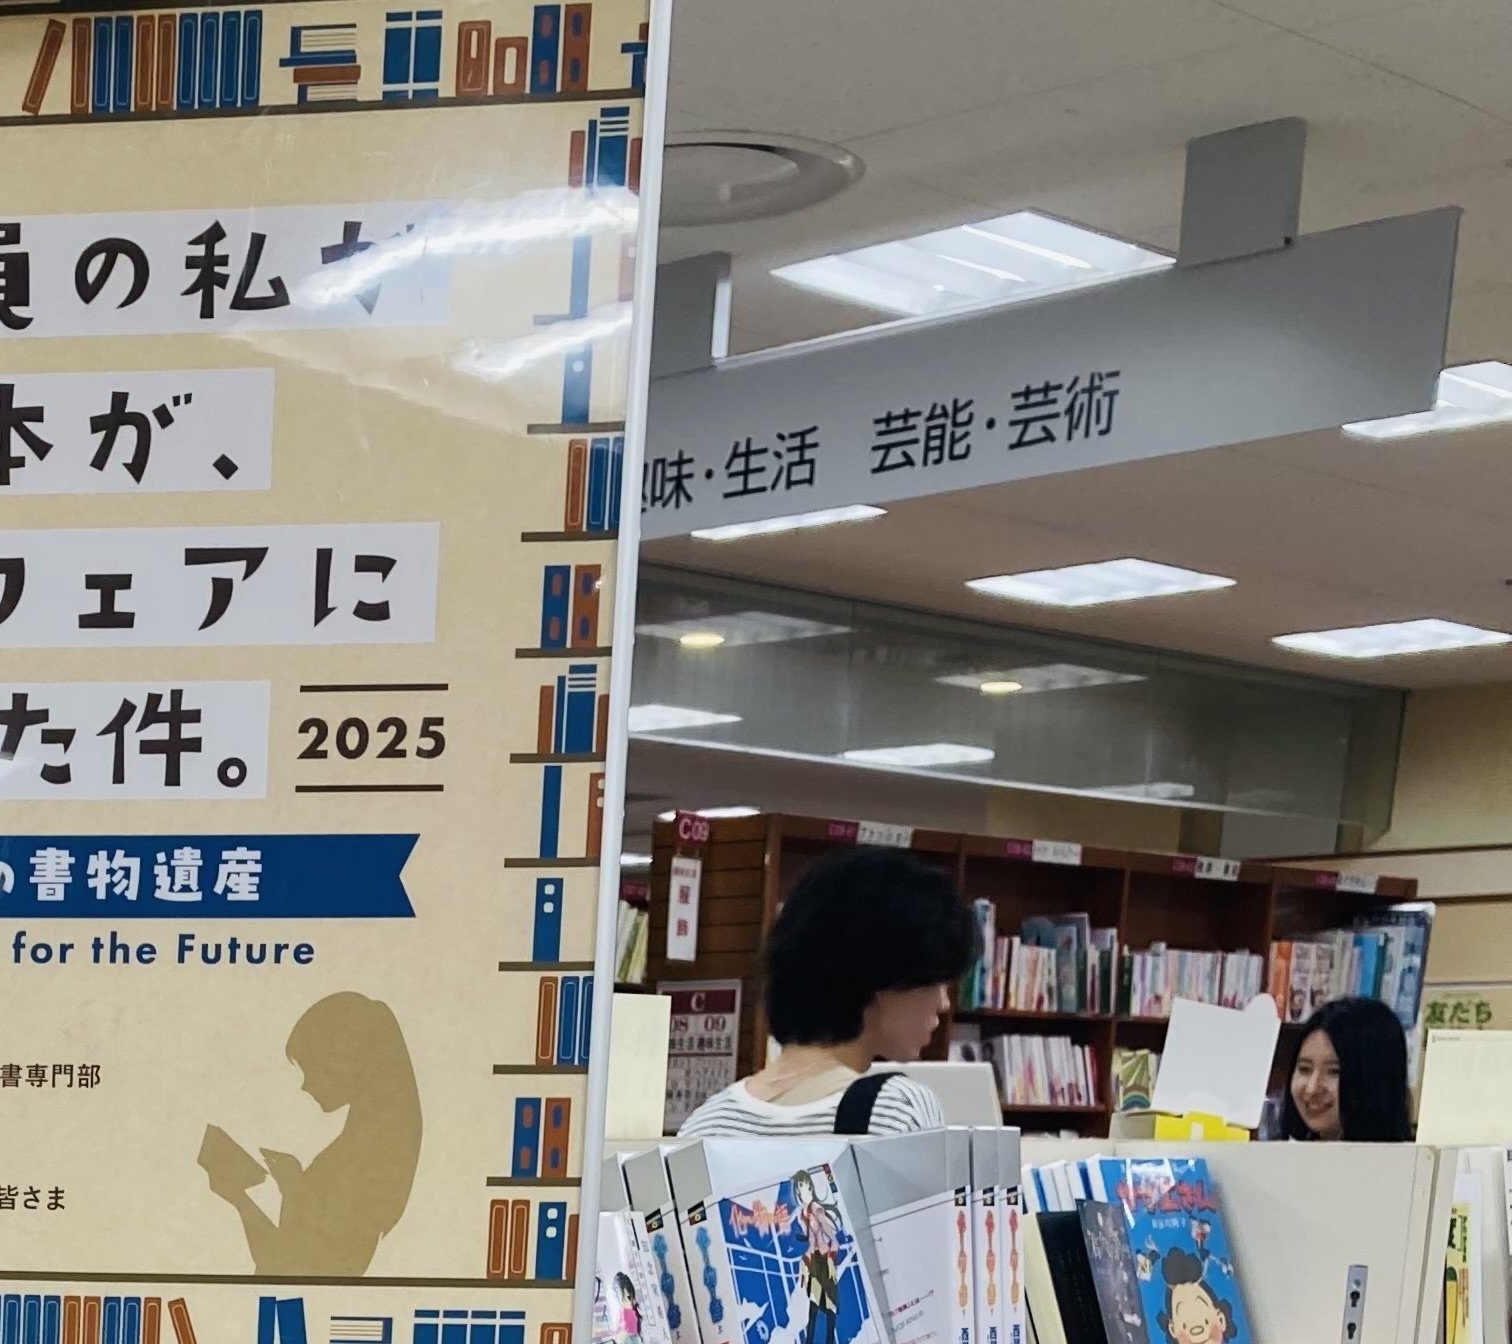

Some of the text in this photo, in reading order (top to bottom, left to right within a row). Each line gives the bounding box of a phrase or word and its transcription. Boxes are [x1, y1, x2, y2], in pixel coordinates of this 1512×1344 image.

[643, 370, 1121, 516] 味・生活 芸能・芸術
[297, 715, 448, 763] 2025
[678, 818, 709, 840] C09
[12, 931, 74, 965] for
[91, 931, 156, 965] the
[177, 933, 314, 967] Future
[691, 993, 706, 1010] C
